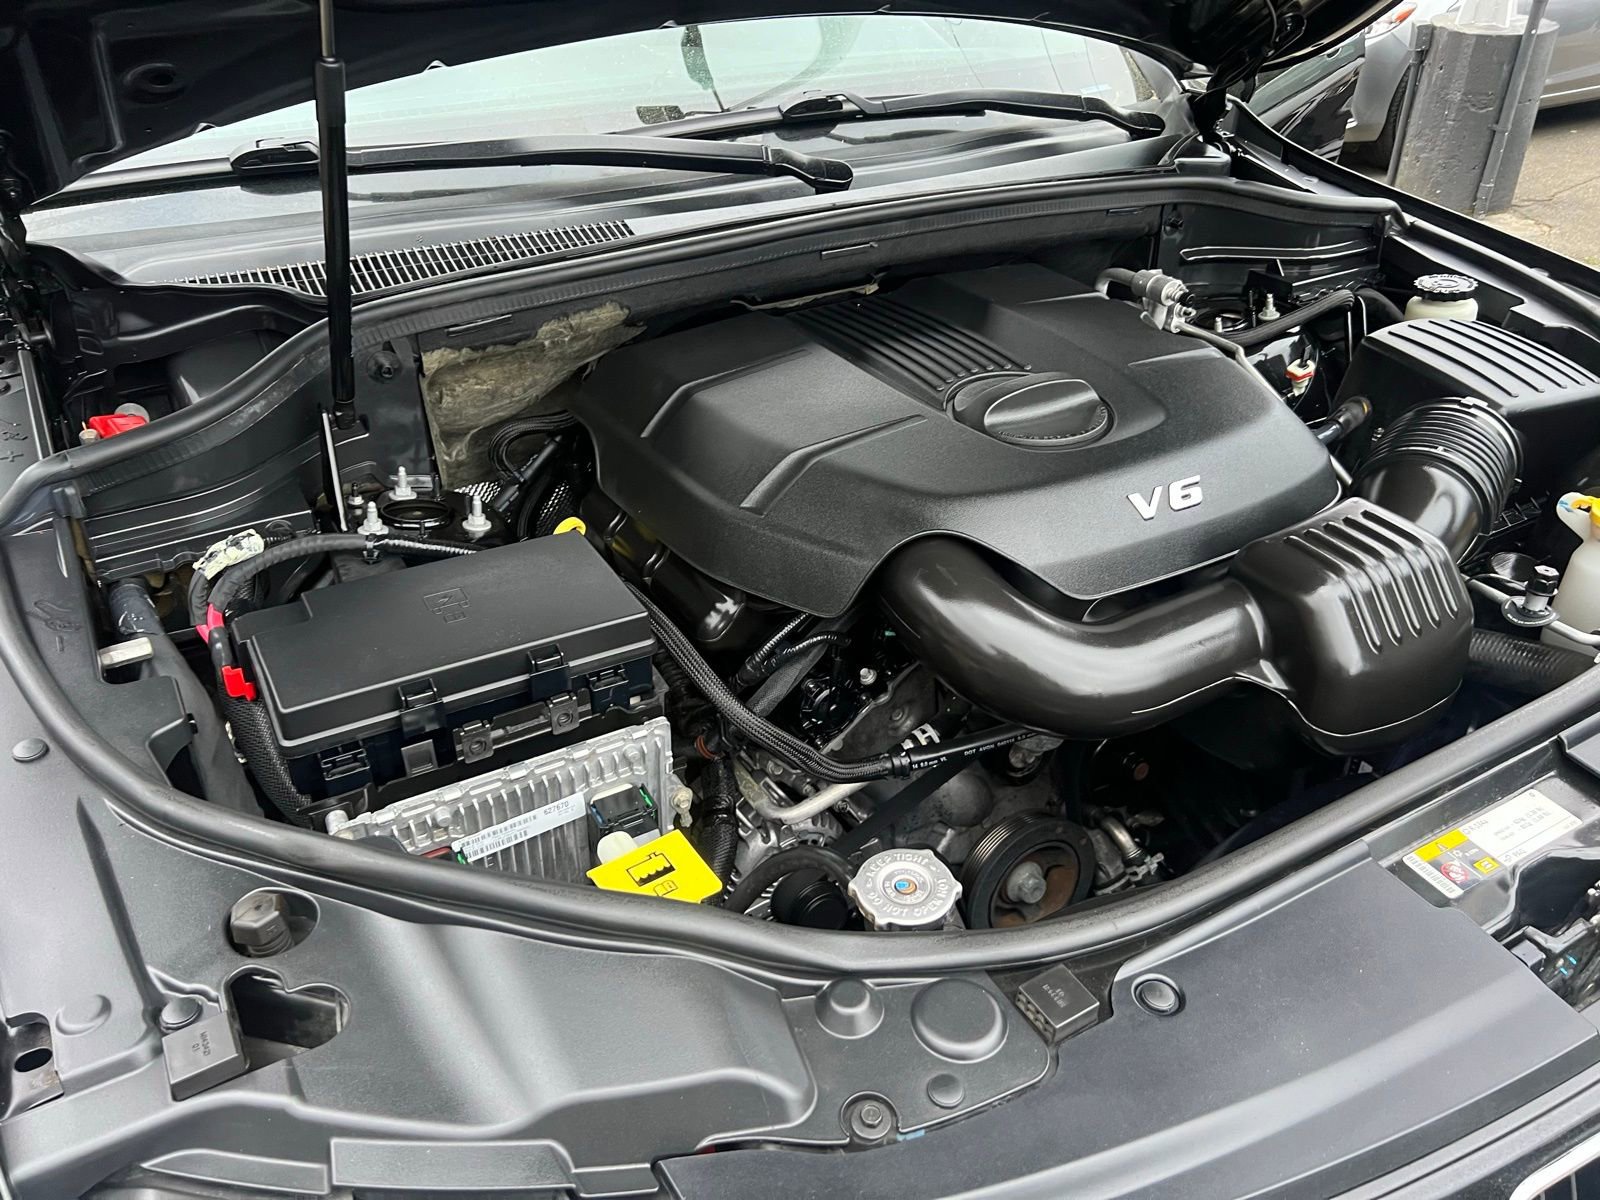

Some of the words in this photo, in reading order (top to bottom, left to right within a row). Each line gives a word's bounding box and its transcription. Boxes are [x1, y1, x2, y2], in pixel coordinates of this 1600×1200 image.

[1126, 475, 1203, 521] V6
[866, 855, 893, 877] KEEP
[893, 853, 929, 865] TIGHT
[882, 903, 910, 917] NOT
[912, 899, 945, 917] OPEN
